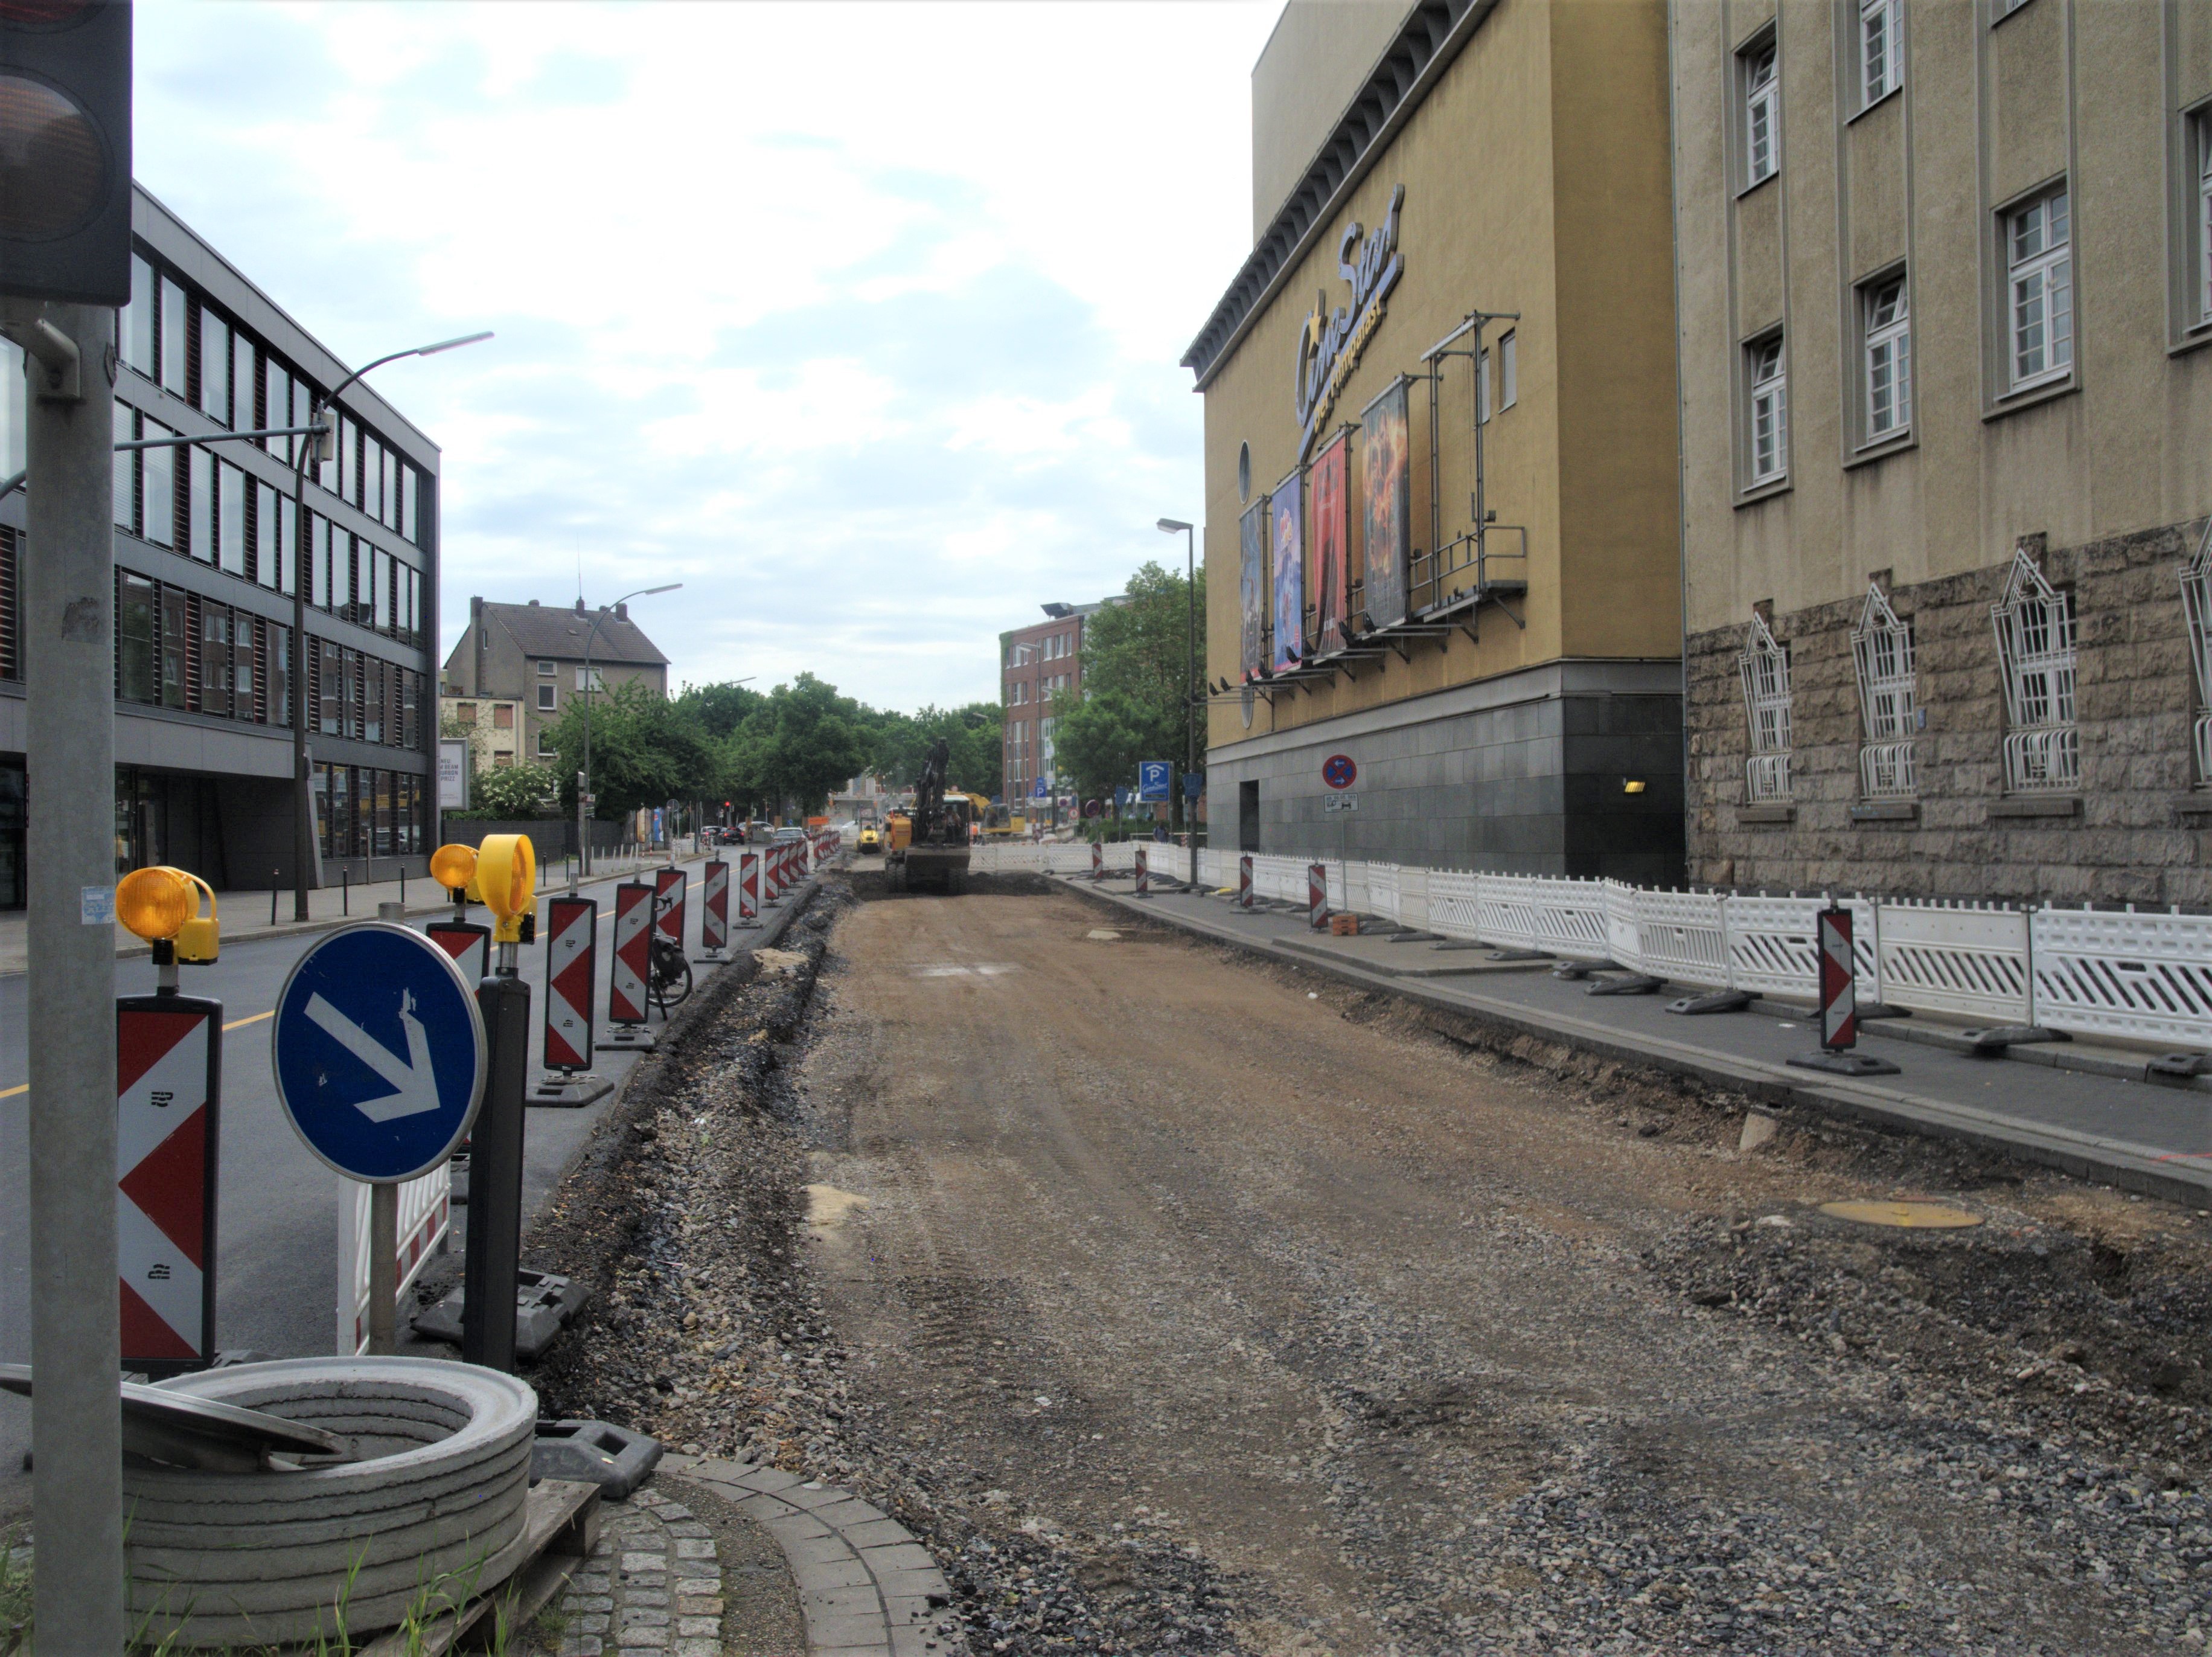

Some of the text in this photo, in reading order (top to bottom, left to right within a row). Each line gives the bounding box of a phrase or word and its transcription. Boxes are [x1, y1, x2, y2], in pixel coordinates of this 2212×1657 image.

[1296, 184, 1404, 427] CineStar
[1331, 289, 1382, 399] Filmpalast
[1037, 787, 1044, 797] P
[1150, 770, 1160, 782] P
